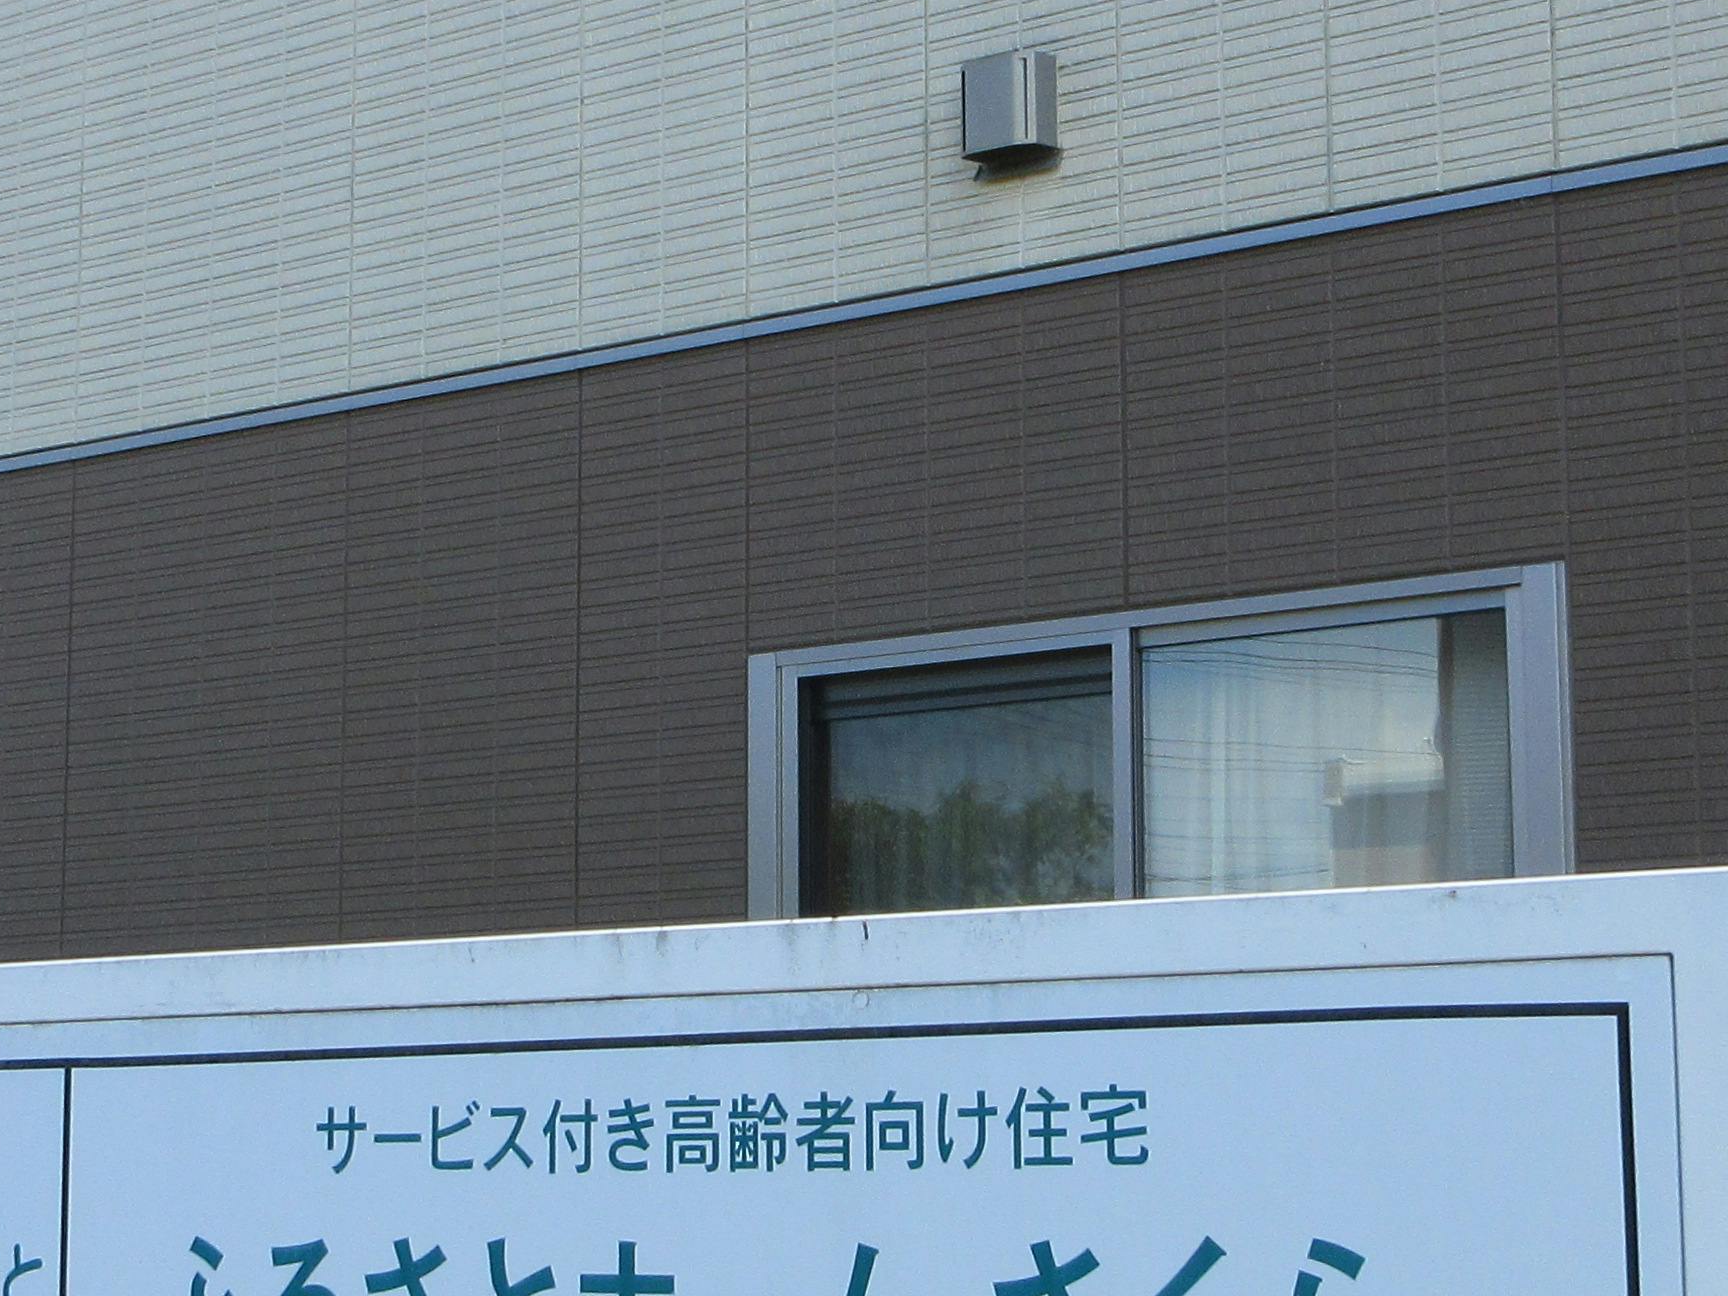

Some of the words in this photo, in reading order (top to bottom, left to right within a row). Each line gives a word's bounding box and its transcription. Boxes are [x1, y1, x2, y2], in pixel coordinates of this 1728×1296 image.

[315, 1082, 1150, 1176] サービス付き高齢者向け住宅
